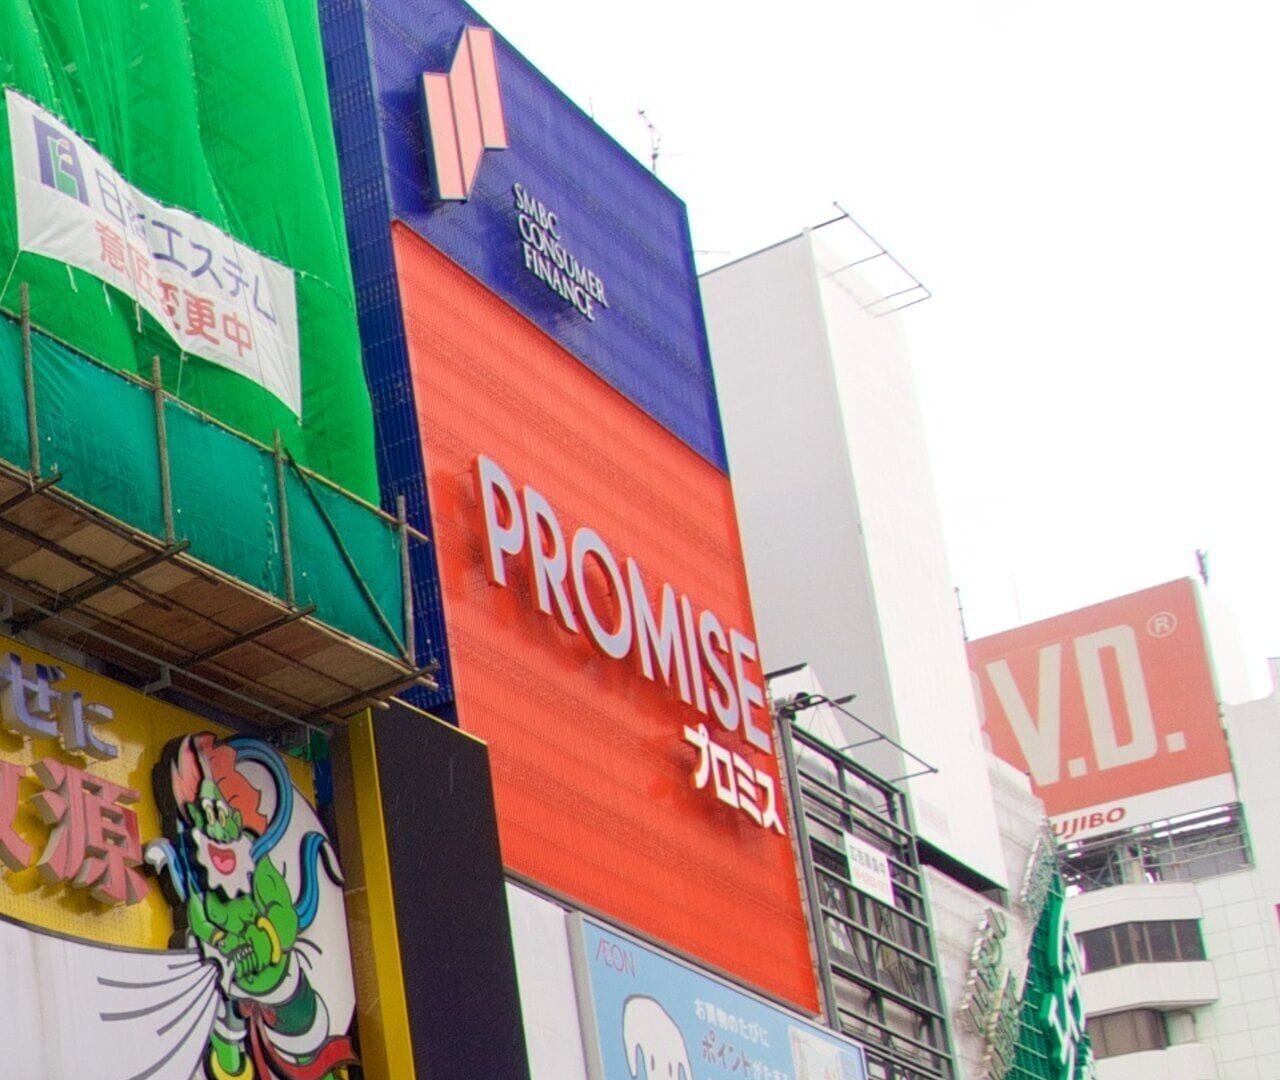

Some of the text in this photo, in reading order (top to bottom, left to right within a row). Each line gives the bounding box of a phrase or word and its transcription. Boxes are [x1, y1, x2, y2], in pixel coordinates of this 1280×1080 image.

[512, 183, 561, 241] SMBC
[518, 214, 609, 310] CONSUMER
[522, 243, 595, 322] FINANCE
[477, 453, 773, 756] PROMISE
[683, 723, 786, 836] プロミス
[1049, 805, 1126, 838] UJIBO
